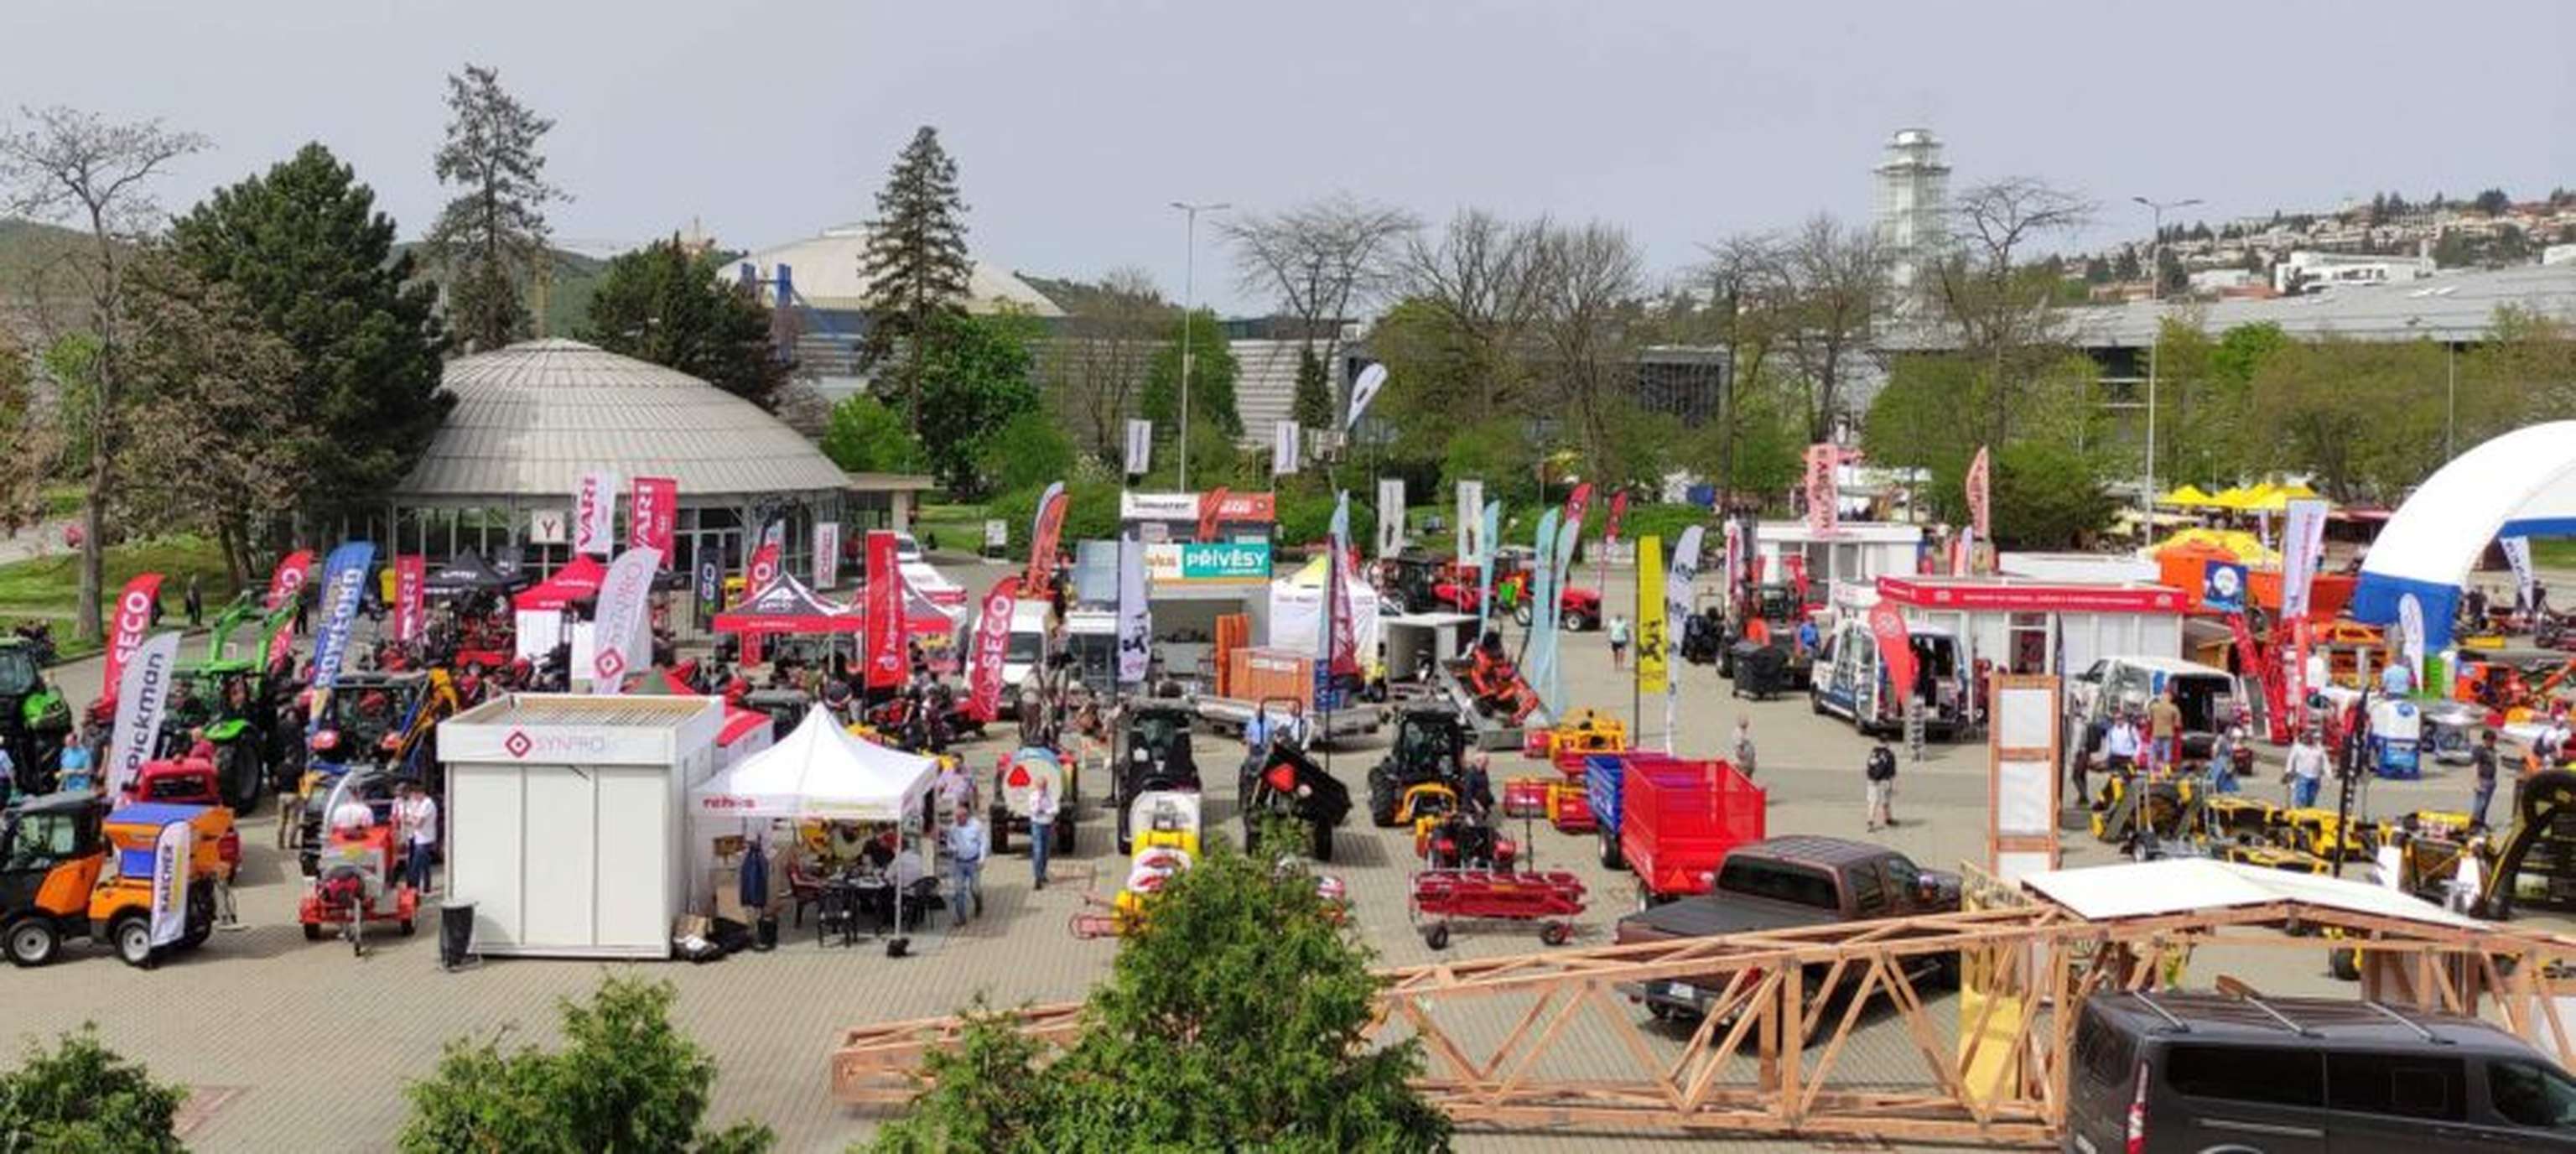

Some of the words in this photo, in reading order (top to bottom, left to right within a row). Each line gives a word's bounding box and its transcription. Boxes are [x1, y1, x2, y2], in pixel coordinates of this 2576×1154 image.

[541, 519, 556, 539] Y
[579, 477, 596, 548] VARI
[1186, 548, 1267, 568] PŘÍVĚSY
[115, 591, 149, 663] SECO
[982, 595, 1011, 669] SECO
[126, 652, 164, 771] Pickman
